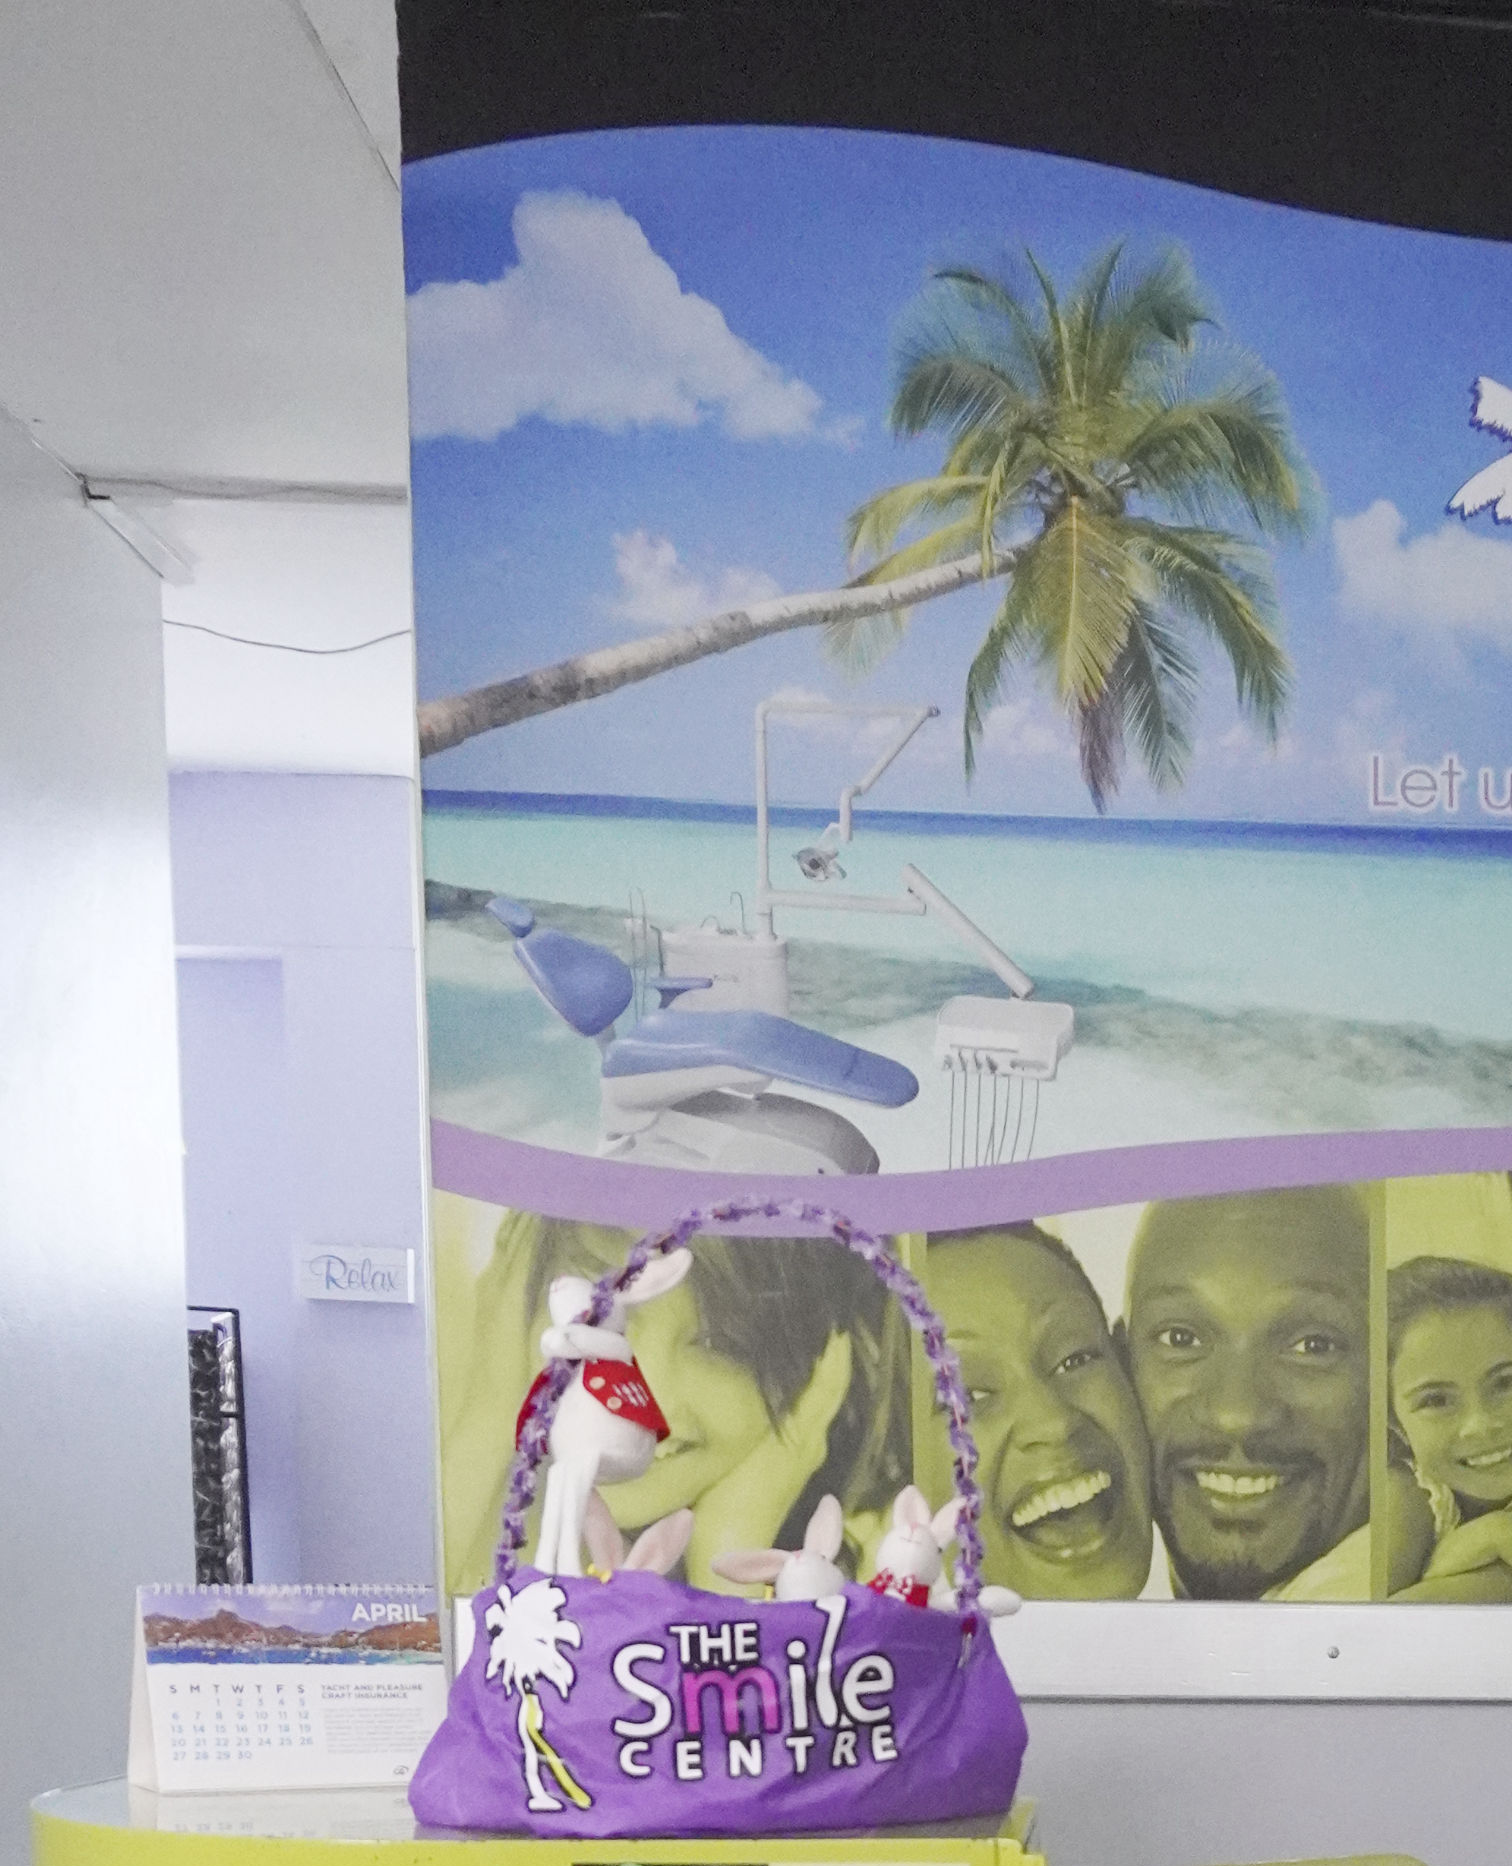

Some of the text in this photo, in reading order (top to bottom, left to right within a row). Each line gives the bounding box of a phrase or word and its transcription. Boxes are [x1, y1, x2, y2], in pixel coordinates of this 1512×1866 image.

[1368, 754, 1461, 811] Let
[309, 1254, 400, 1292] Relax
[351, 1602, 427, 1623] APRIL
[612, 1597, 894, 1736] Smile
[670, 1625, 758, 1664] THE
[618, 1726, 899, 1779] CENTRE
